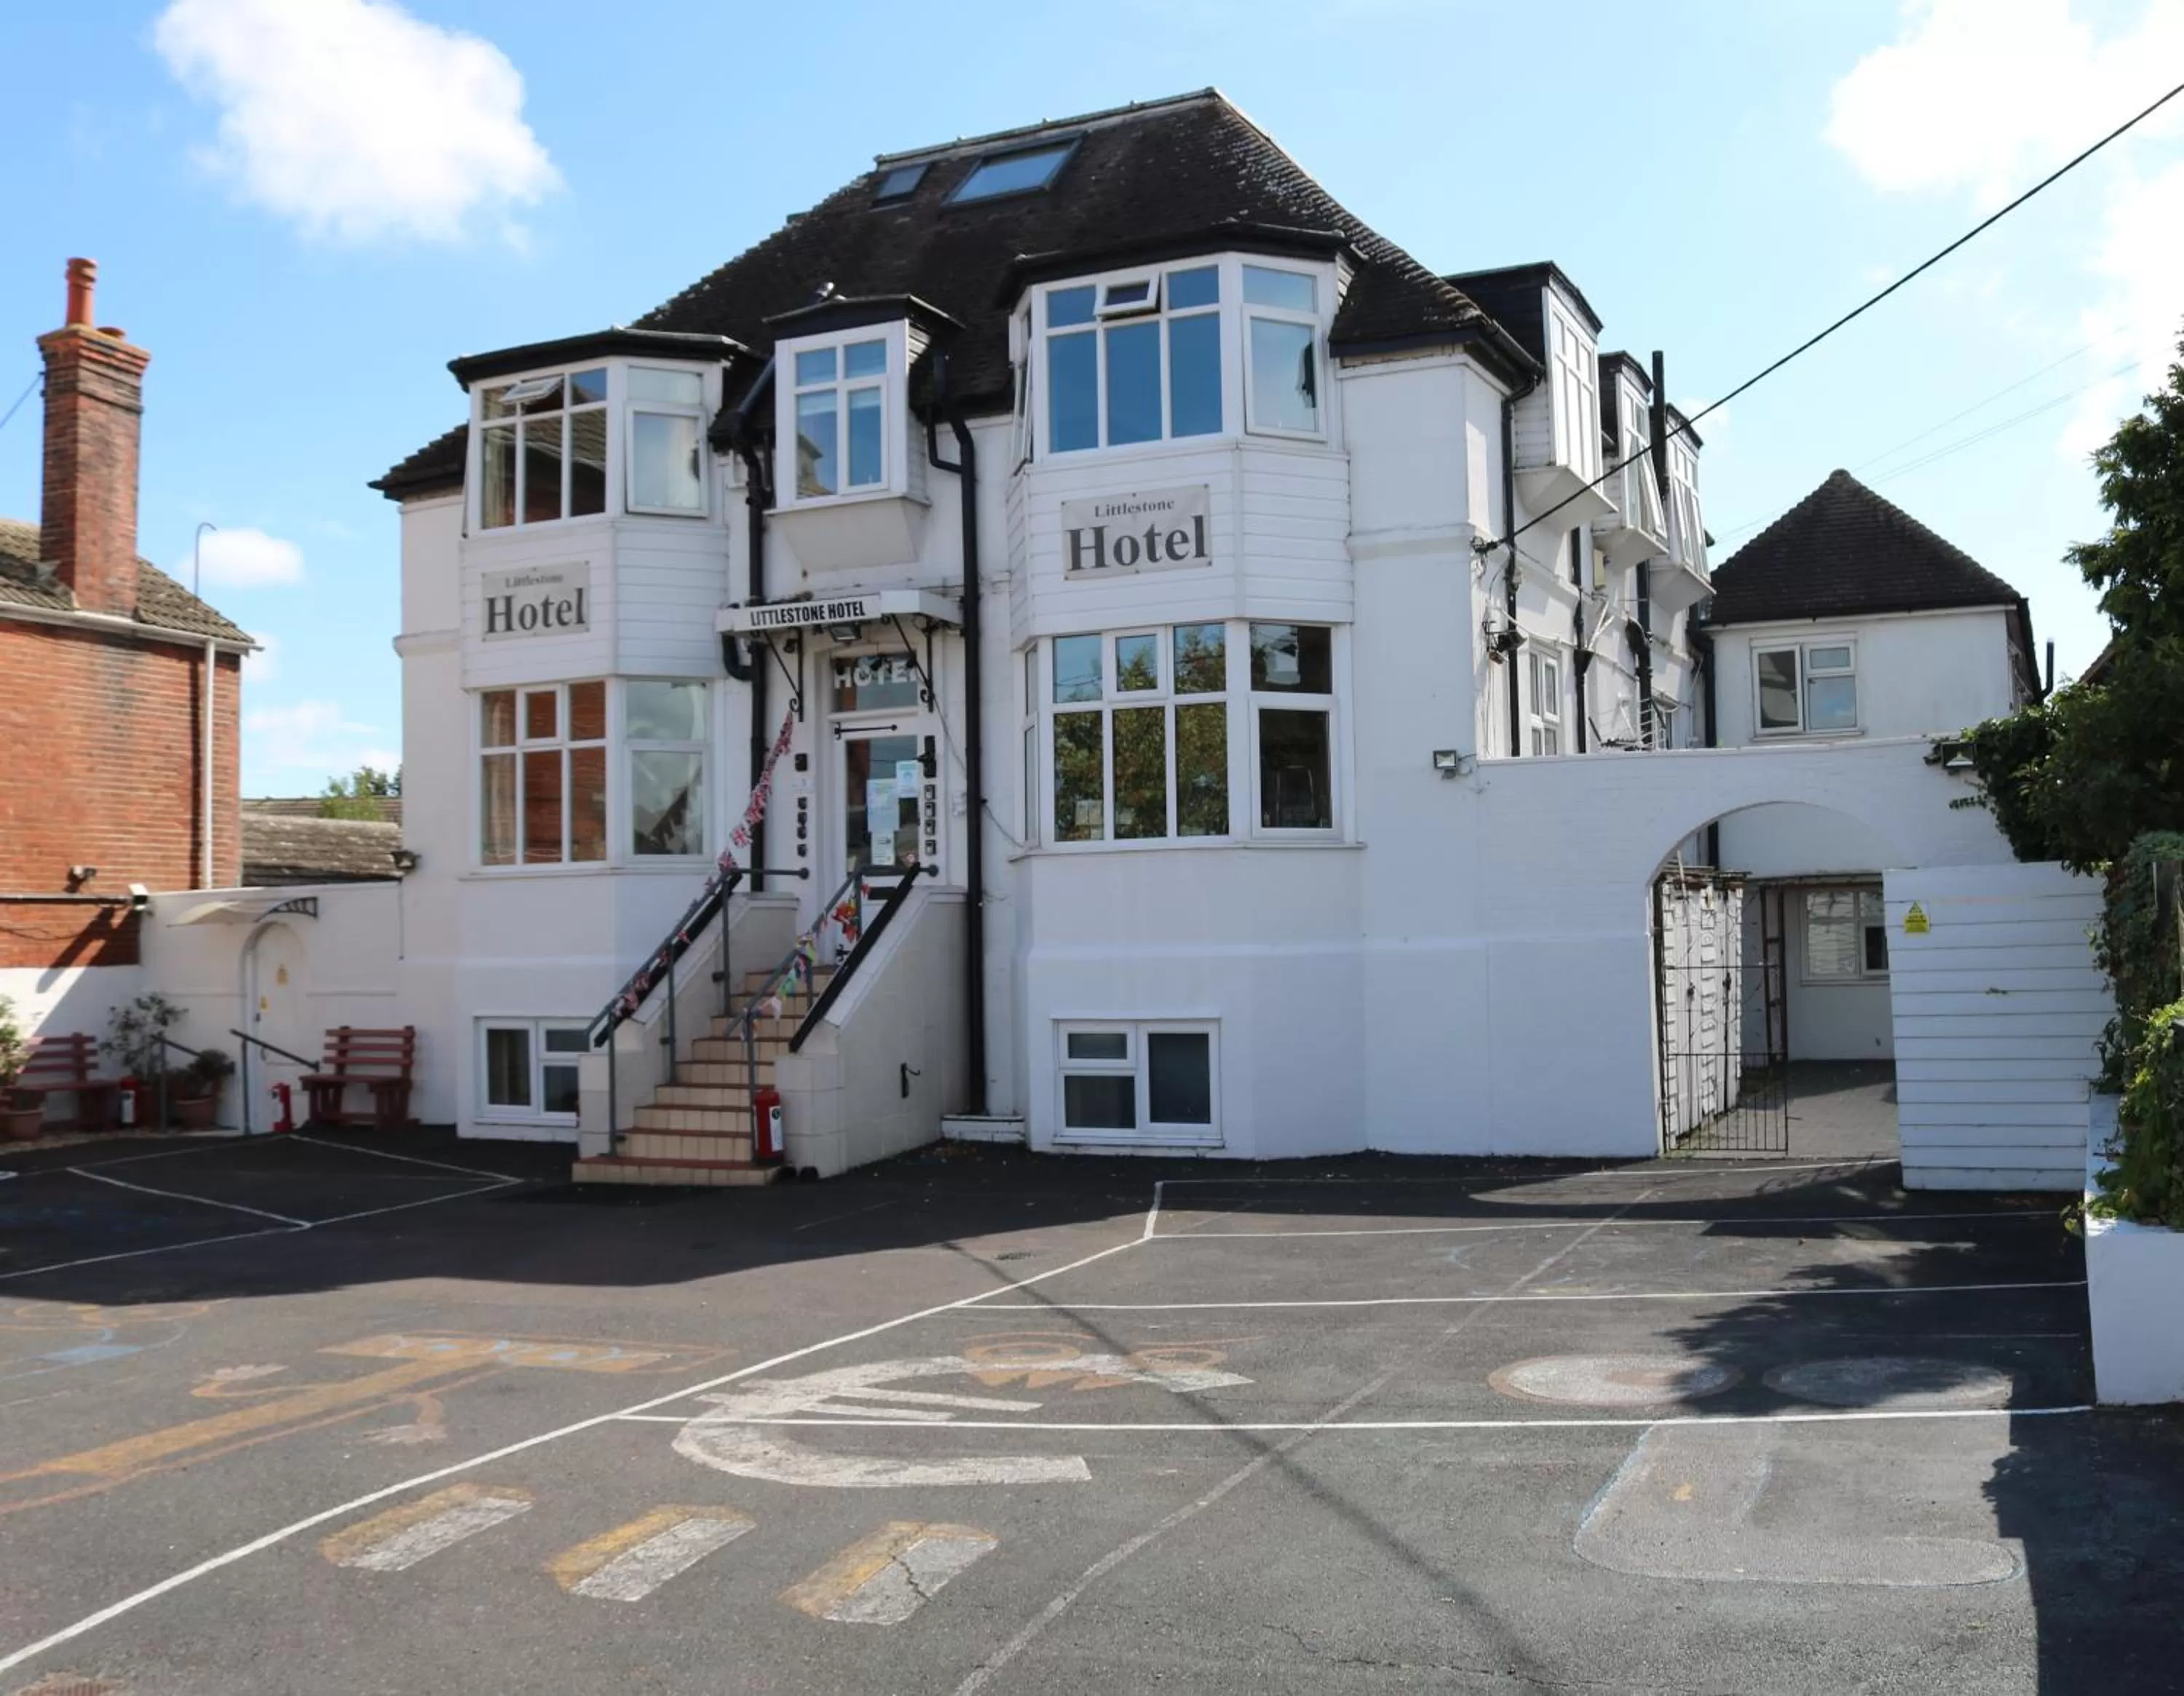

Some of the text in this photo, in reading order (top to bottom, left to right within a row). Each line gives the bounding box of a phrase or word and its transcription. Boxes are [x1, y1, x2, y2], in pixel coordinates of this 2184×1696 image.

[1094, 500, 1174, 518] Littlestone
[1064, 514, 1208, 571] Hotel
[484, 587, 587, 634] Hotel
[750, 601, 866, 627] LITTLESTONE HOTEL
